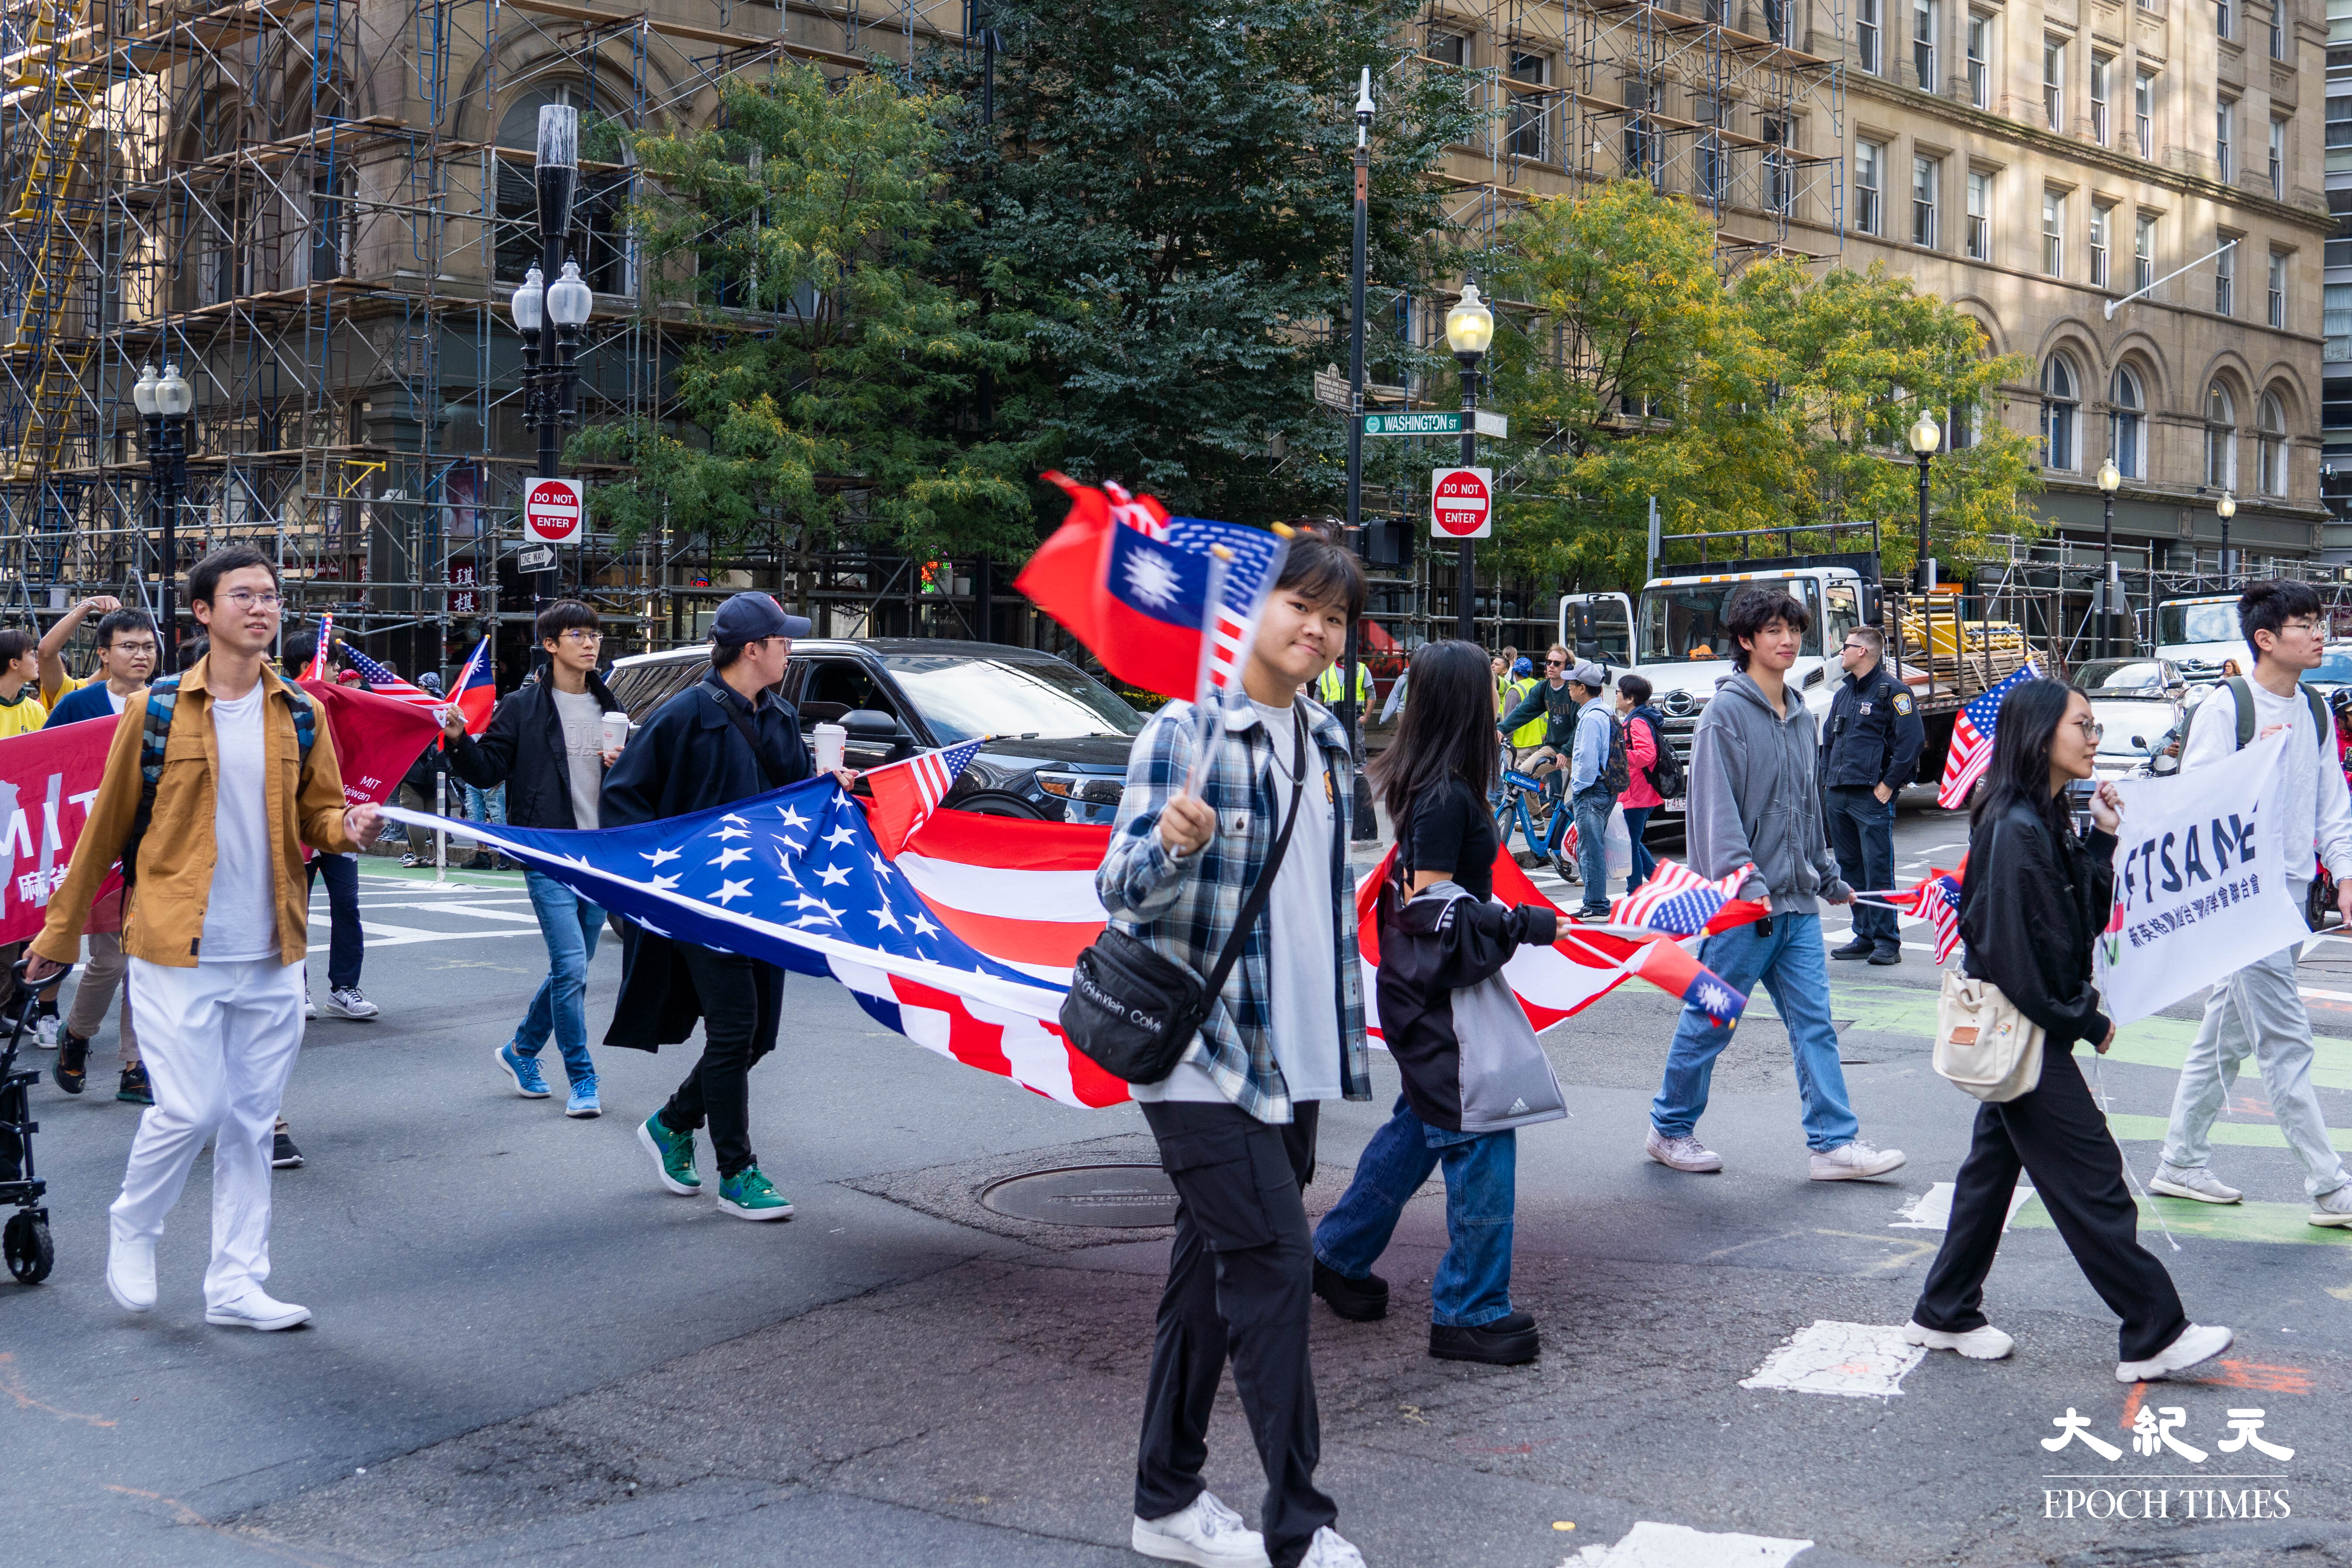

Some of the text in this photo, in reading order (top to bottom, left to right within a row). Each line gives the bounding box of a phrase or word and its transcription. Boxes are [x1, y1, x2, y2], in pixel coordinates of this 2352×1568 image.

[1321, 391, 1335, 399] OCTOBER
[1384, 414, 1457, 431] WASHINGTON ST
[1444, 483, 1479, 494] DO NOT
[535, 493, 573, 504] DO NOT
[537, 517, 569, 528] ENTER
[1445, 512, 1476, 524] ENTER
[521, 551, 545, 565] ONE WAY
[1545, 700, 1569, 714] Vail
[360, 775, 382, 790] MIT
[1511, 775, 1537, 788] BLUEbikes
[343, 784, 370, 802] Taiwan
[1082, 981, 1103, 1004] Calvin
[1102, 994, 1125, 1017] Klein
